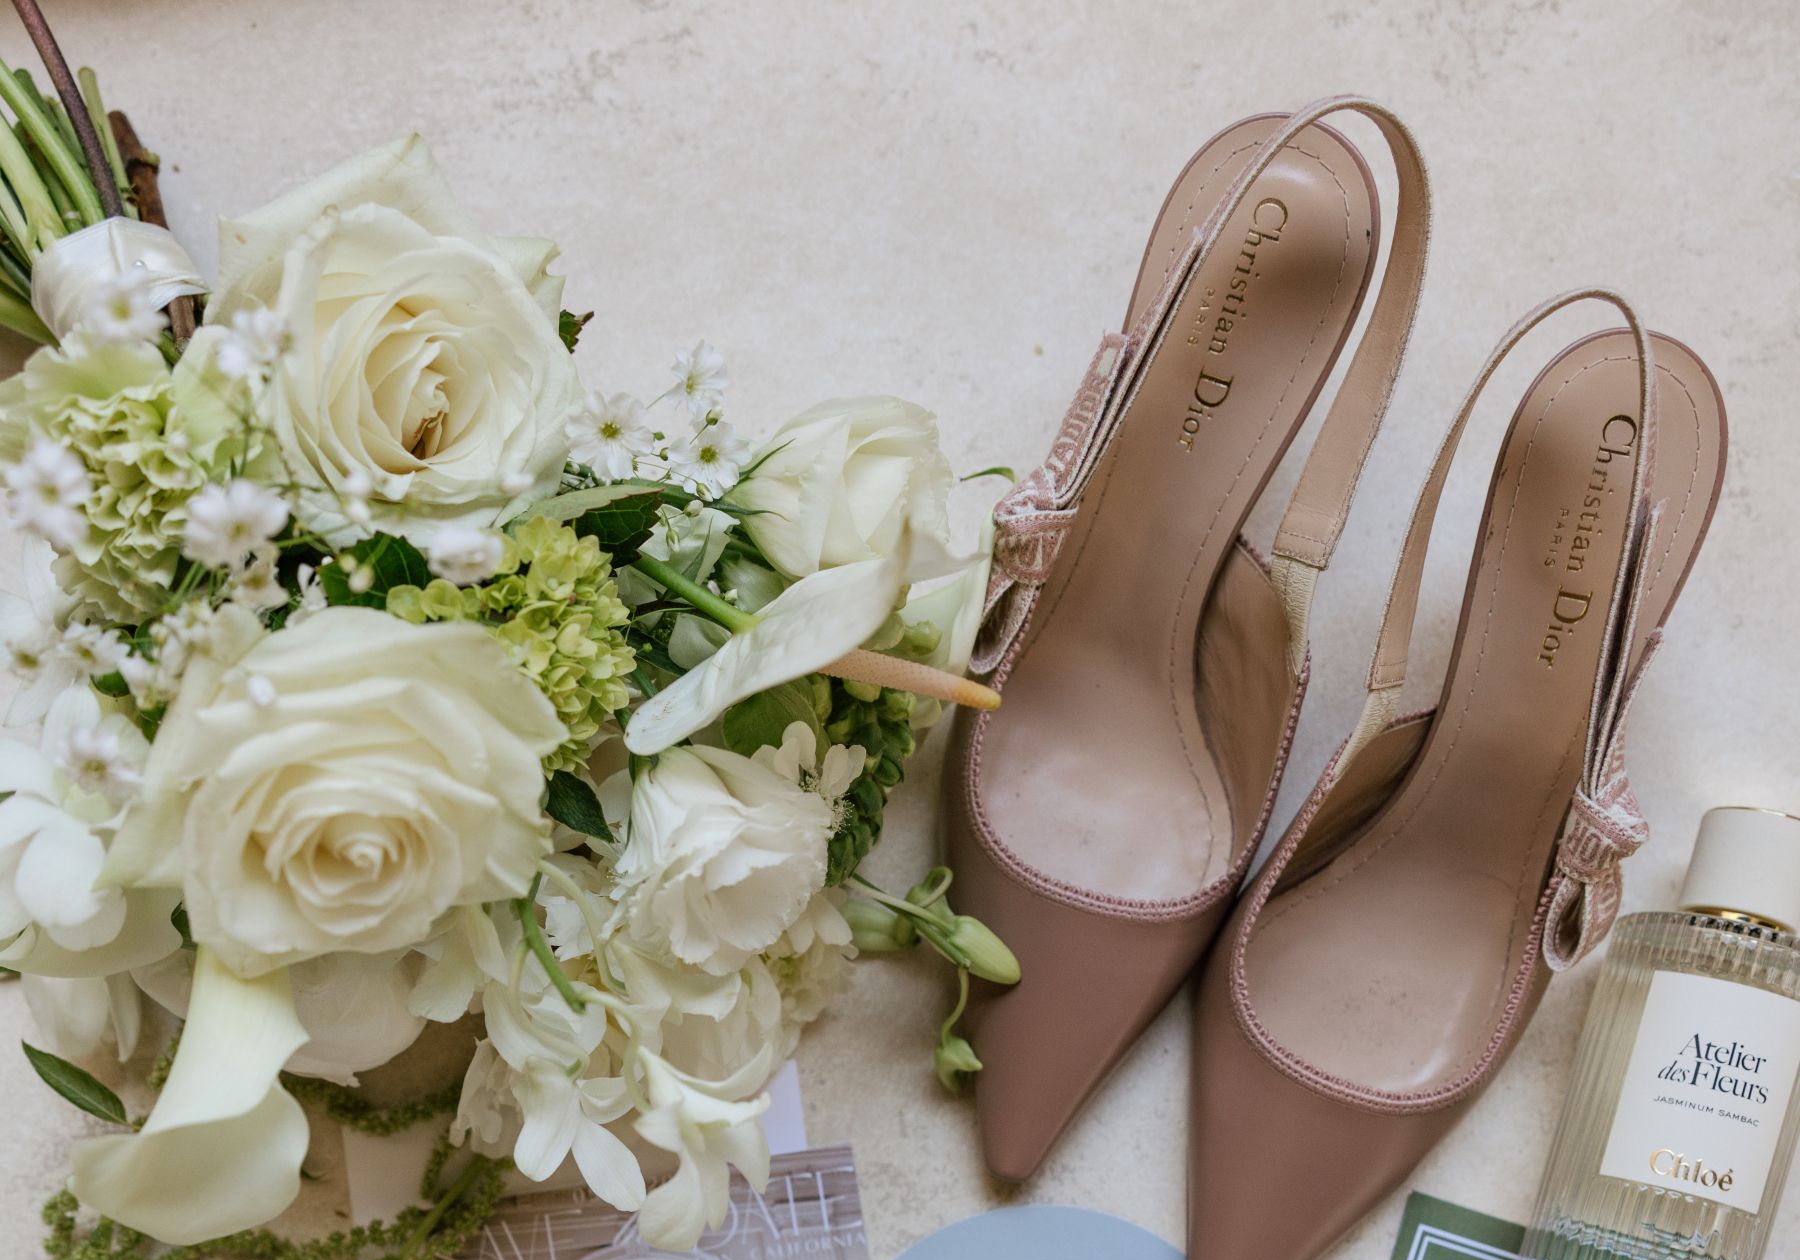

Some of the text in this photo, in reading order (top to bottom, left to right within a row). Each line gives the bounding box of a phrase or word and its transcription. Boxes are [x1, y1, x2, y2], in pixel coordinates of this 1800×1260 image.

[1177, 197, 1289, 453] Christian Dior
[1537, 414, 1637, 669] Christian Dior
[1544, 507, 1570, 568] PARIS
[1679, 1033, 1767, 1074] Atelier
[1657, 1060, 1769, 1105] des Fleurs
[1653, 1095, 1760, 1127] JASMINUM SAMBAC
[1649, 1148, 1734, 1192] Chloé
